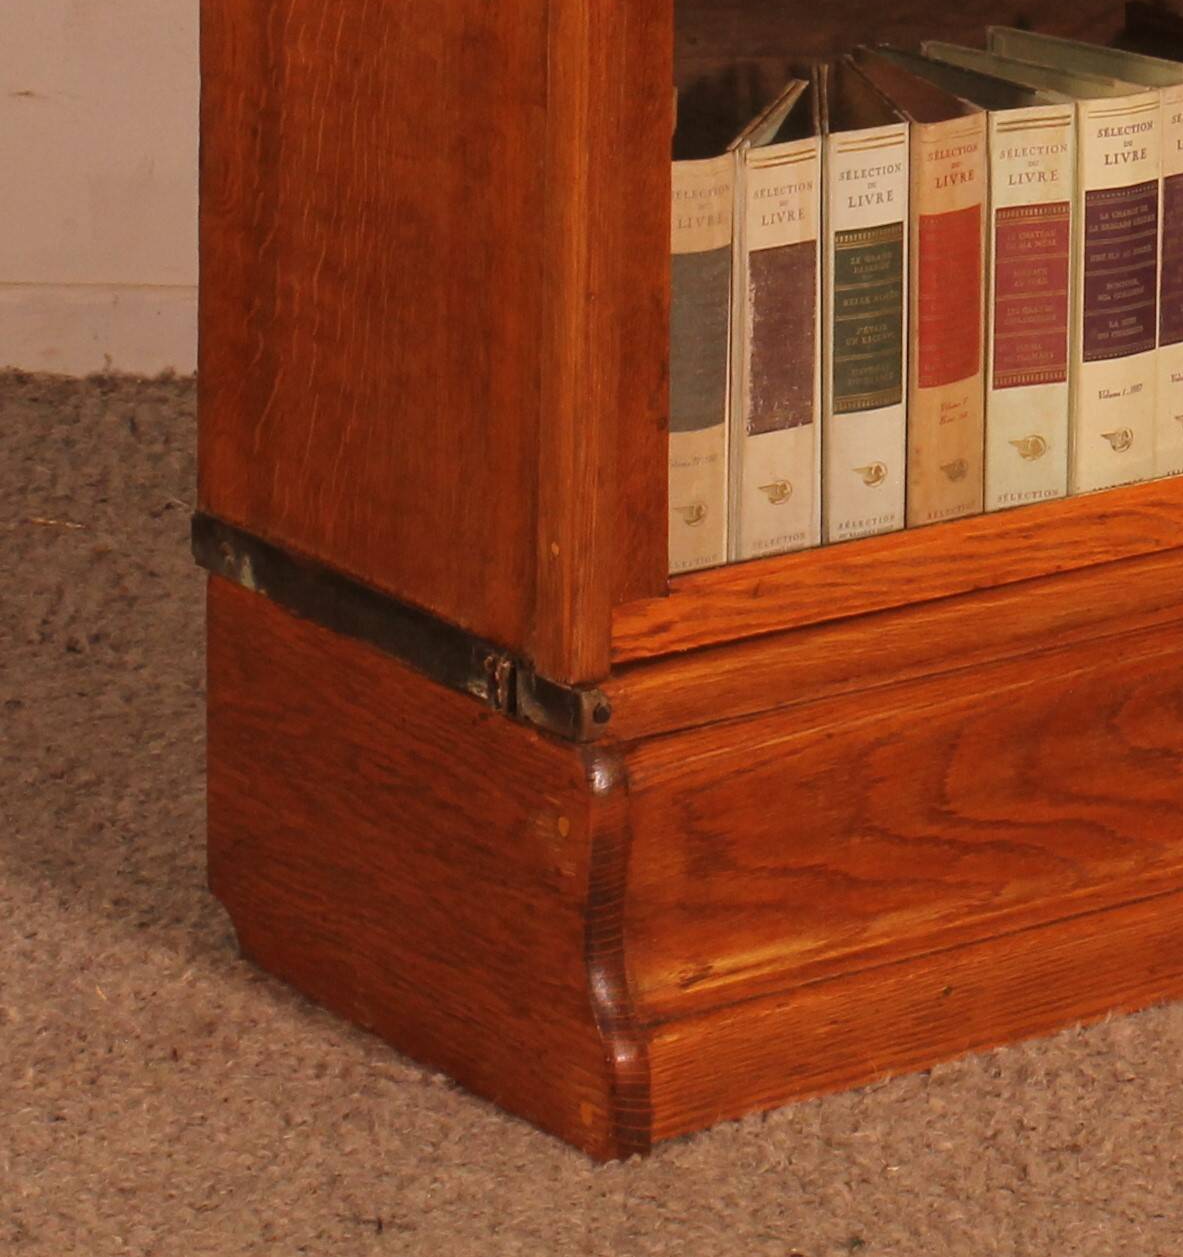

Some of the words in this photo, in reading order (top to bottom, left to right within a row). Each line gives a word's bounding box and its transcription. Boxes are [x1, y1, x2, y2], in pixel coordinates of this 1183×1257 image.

[1104, 147, 1147, 165] LIVRE
[935, 169, 975, 189] LIVRE
[1008, 169, 1060, 185] LIVRE
[848, 190, 894, 208] LIVRE
[761, 209, 806, 227] LIVRE
